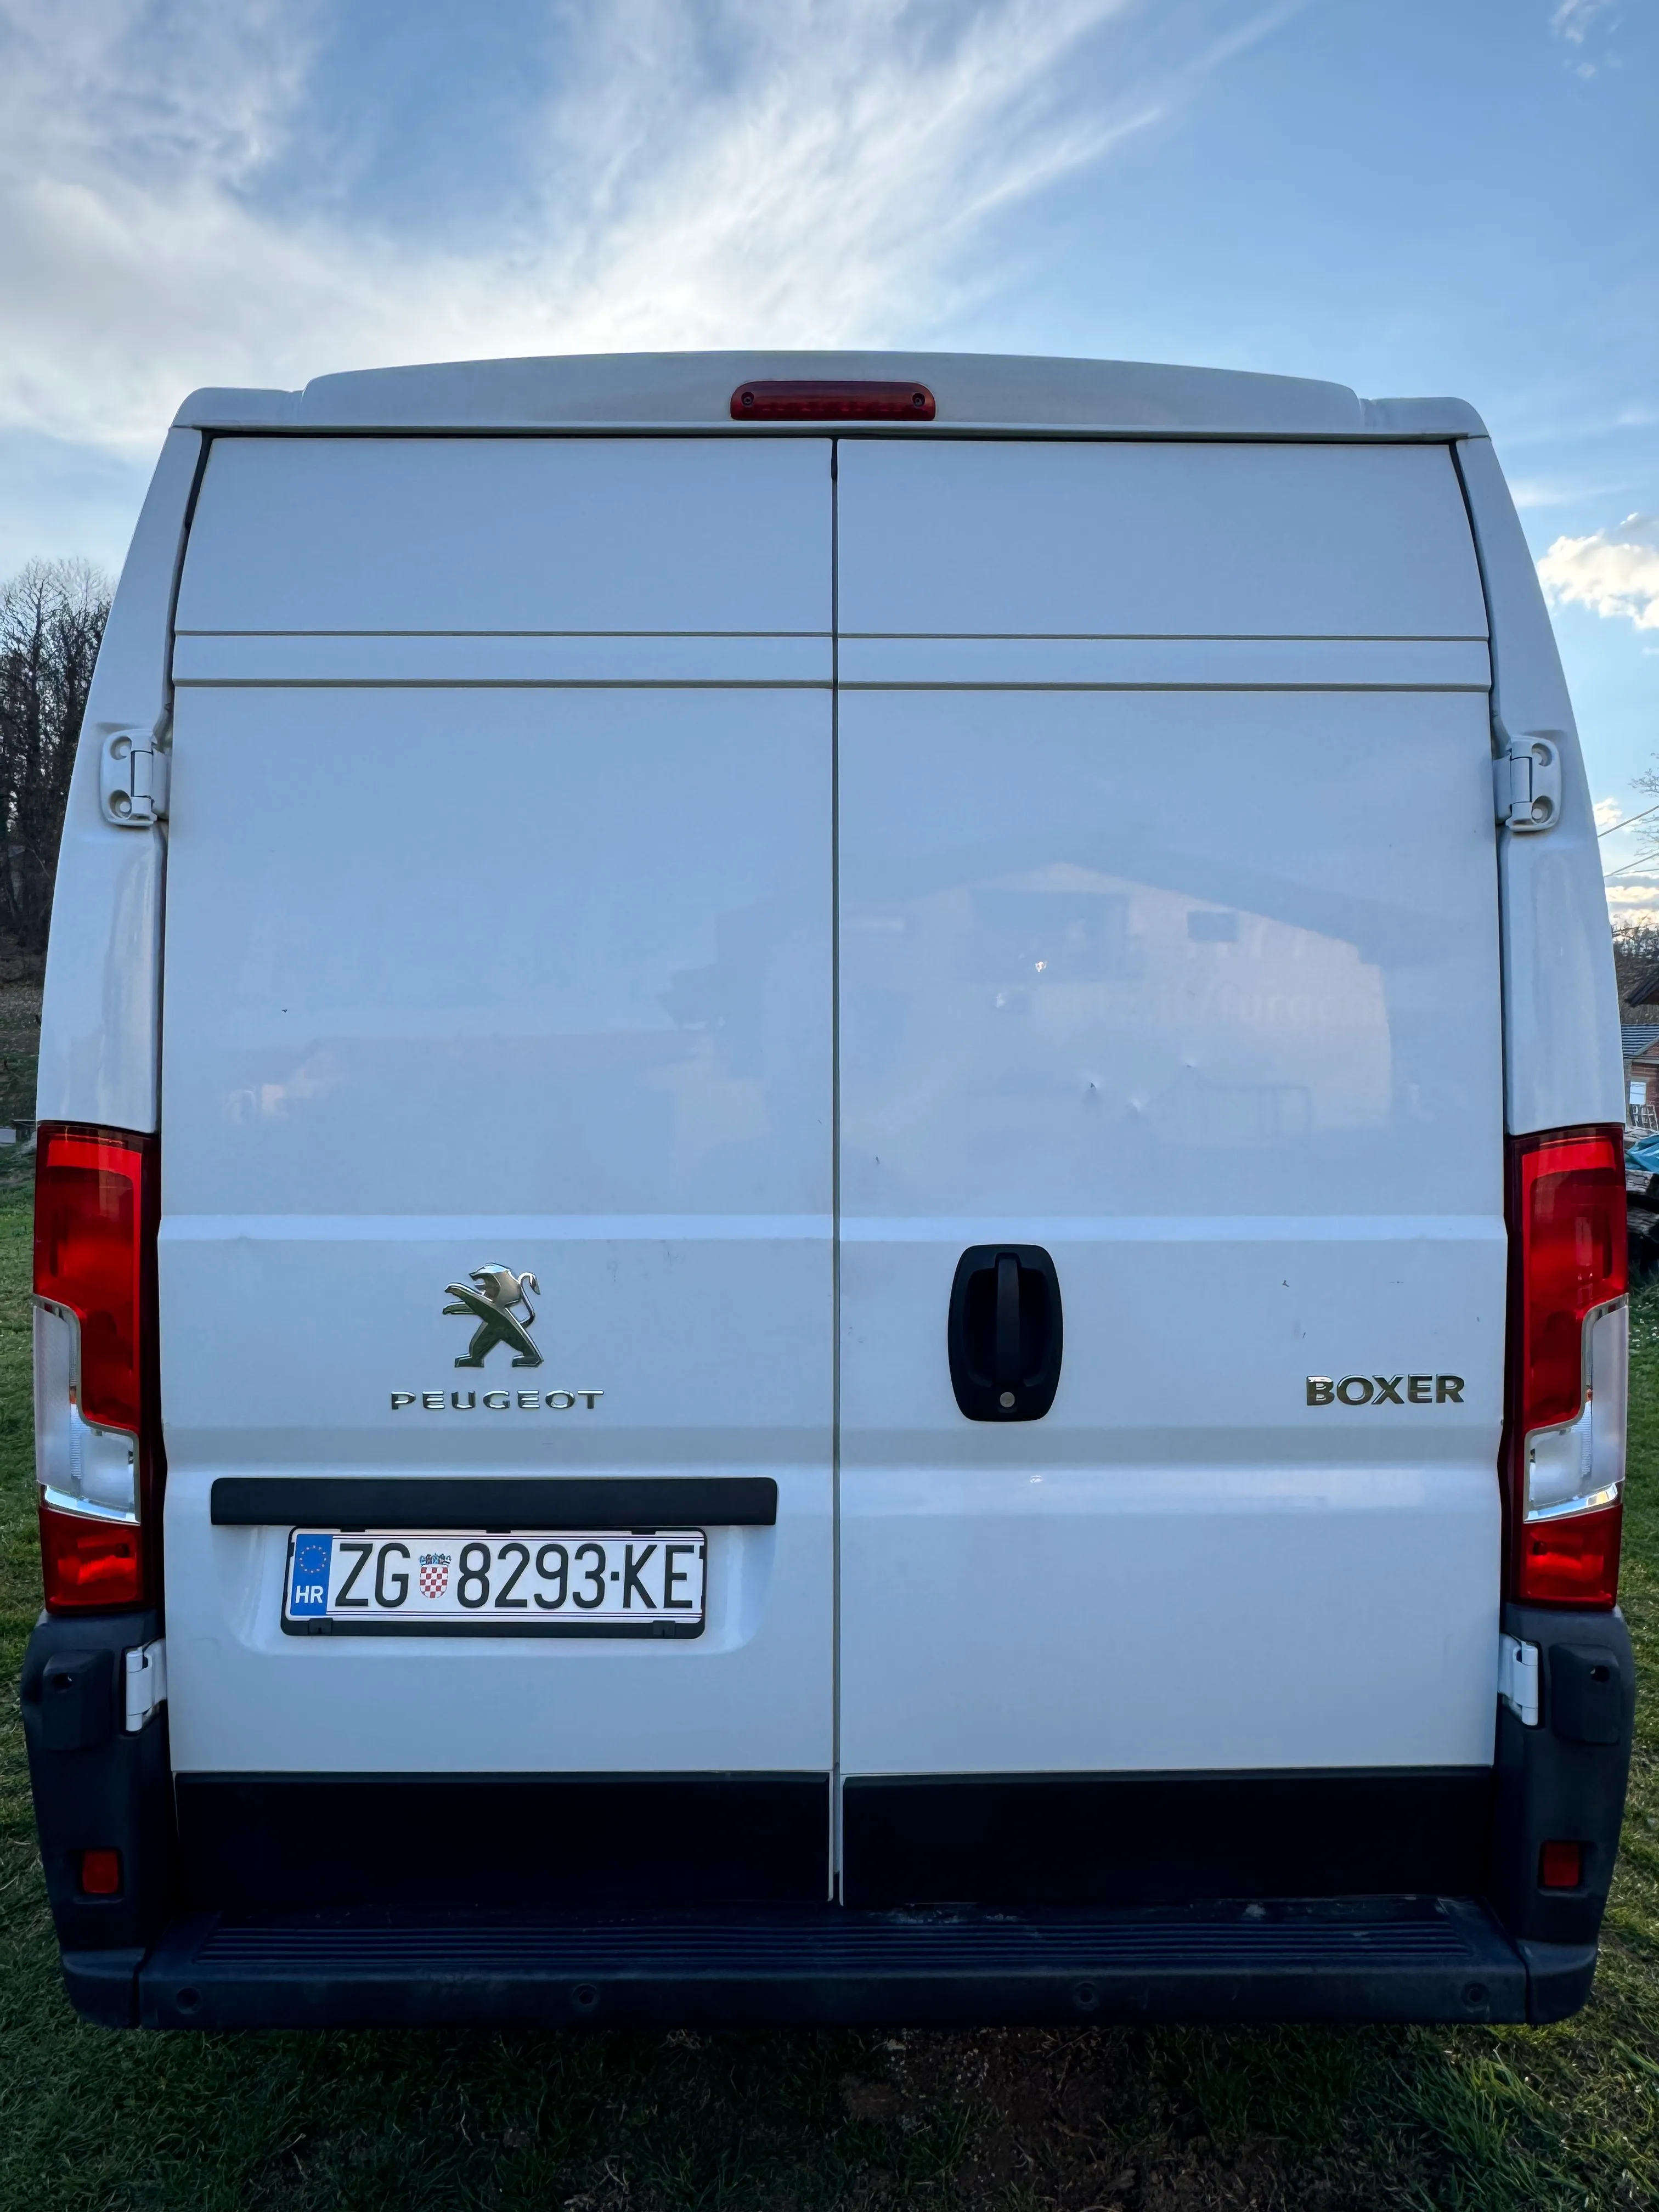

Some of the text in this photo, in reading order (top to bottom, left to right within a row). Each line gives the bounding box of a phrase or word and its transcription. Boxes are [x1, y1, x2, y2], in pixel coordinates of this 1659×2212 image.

[391, 1389, 604, 1410] PEUGEOT
[1306, 1373, 1465, 1406] BOXER
[334, 1543, 411, 1608] ZG
[295, 1585, 323, 1605] HR
